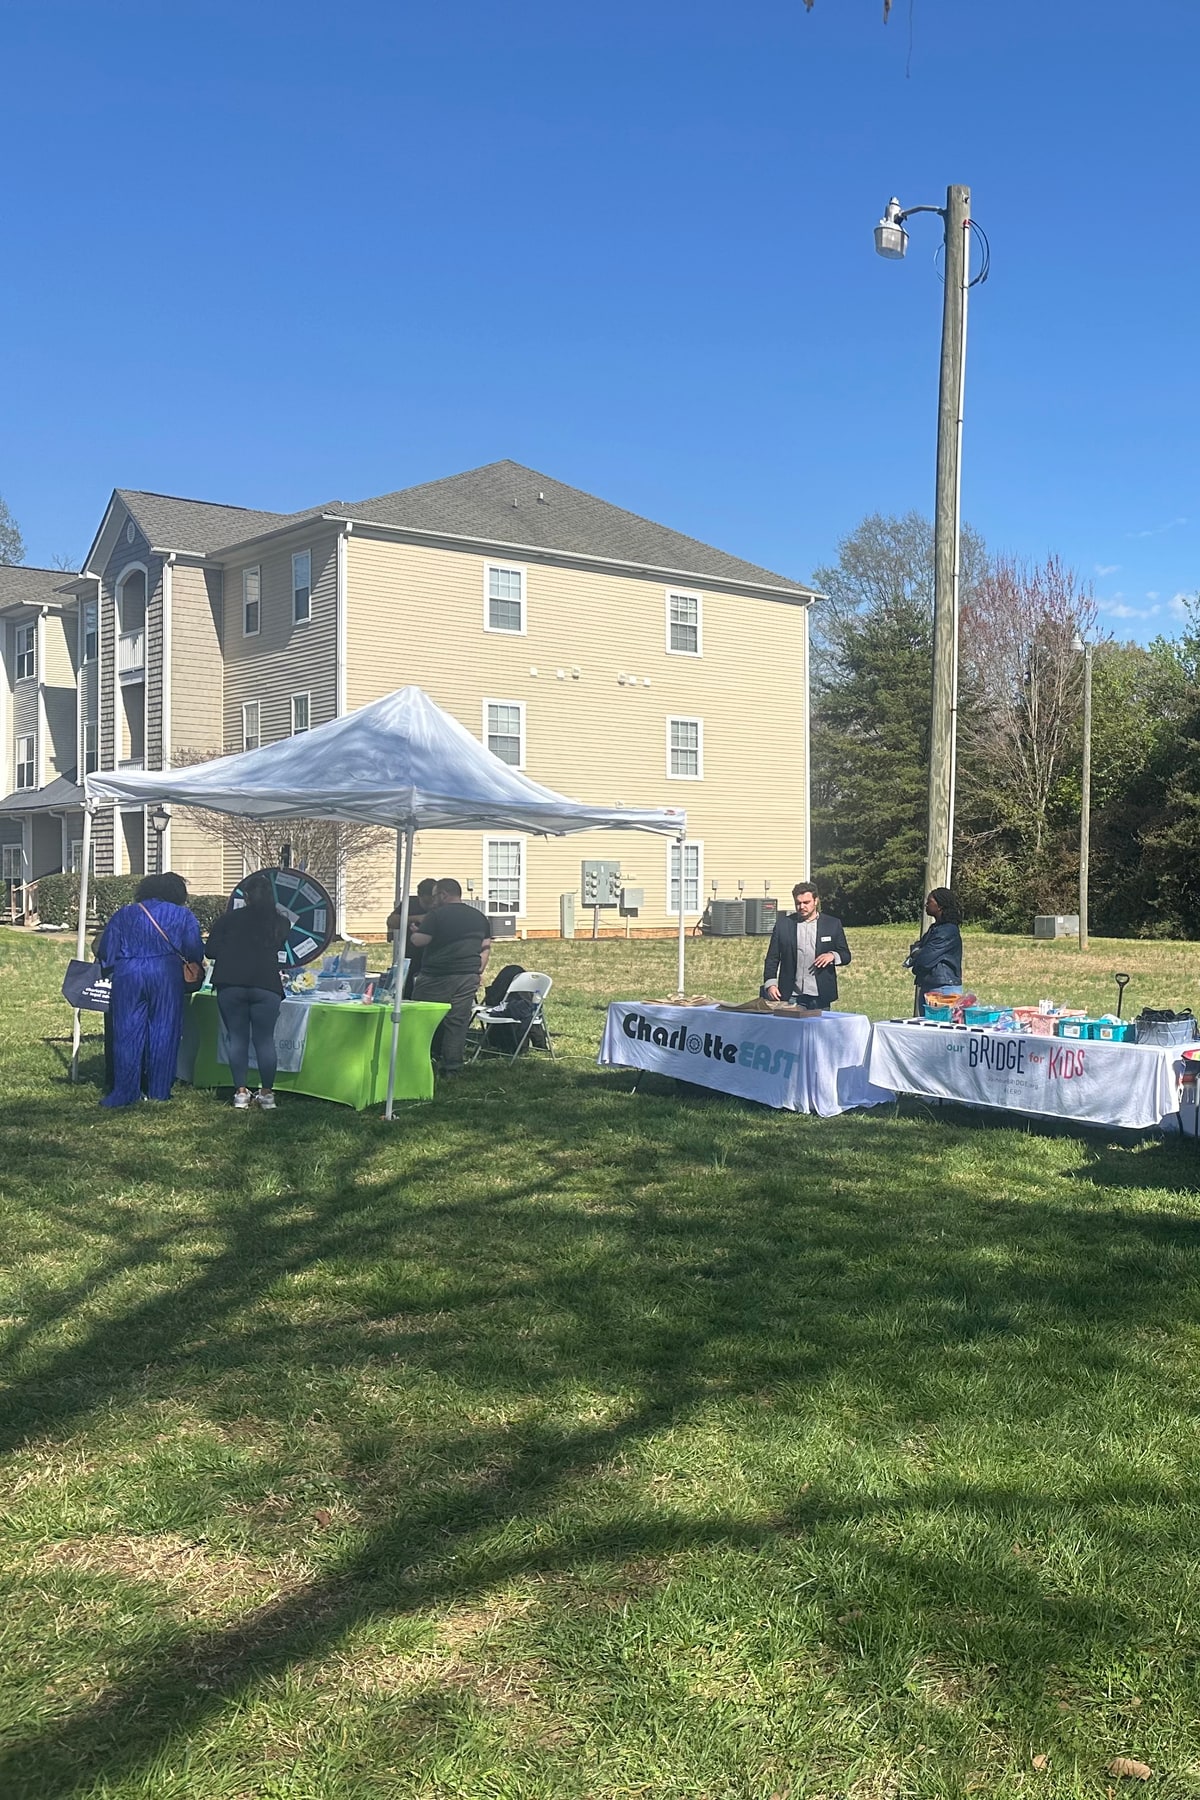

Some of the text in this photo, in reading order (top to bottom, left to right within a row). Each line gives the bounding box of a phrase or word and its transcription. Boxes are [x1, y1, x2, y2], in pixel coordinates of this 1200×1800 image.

[946, 1043, 965, 1053] our
[968, 1034, 1026, 1075] BRIDGE
[1029, 1051, 1045, 1064] for
